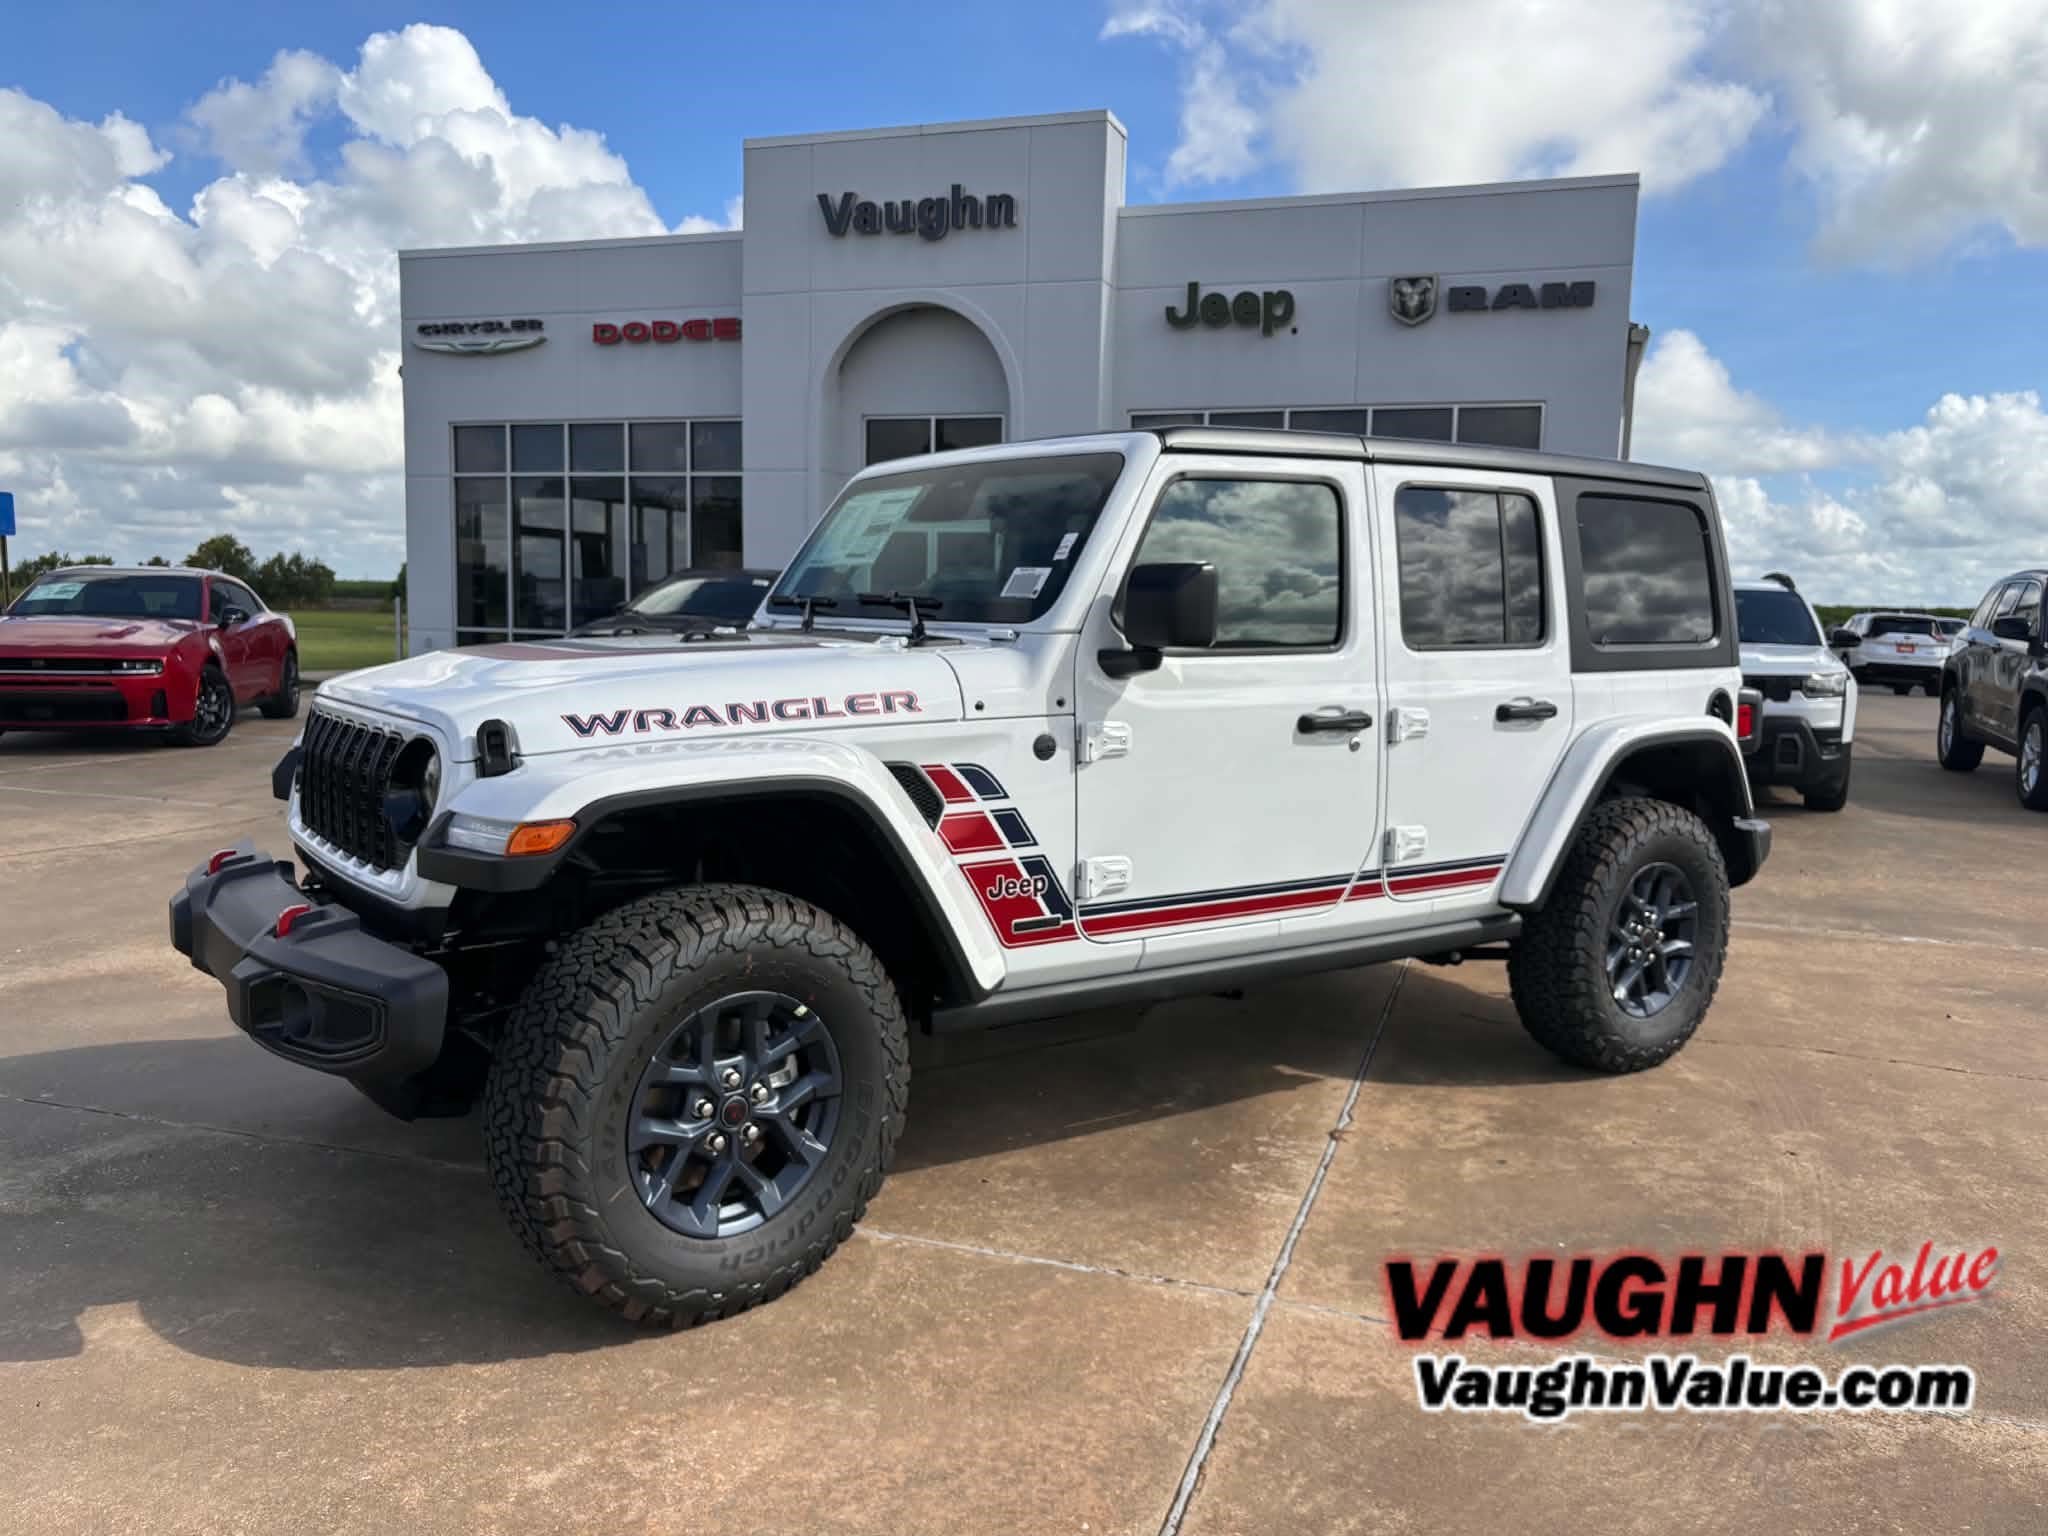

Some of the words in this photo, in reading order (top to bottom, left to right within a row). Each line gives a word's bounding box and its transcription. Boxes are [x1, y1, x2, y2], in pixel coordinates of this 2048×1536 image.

[817, 184, 1017, 240] Vaughn
[1448, 281, 1595, 312] RAM
[417, 319, 544, 336] CHRYSLER
[592, 317, 742, 345] DODGE
[561, 690, 923, 737] WRANGLER
[986, 875, 1048, 900] Jeep
